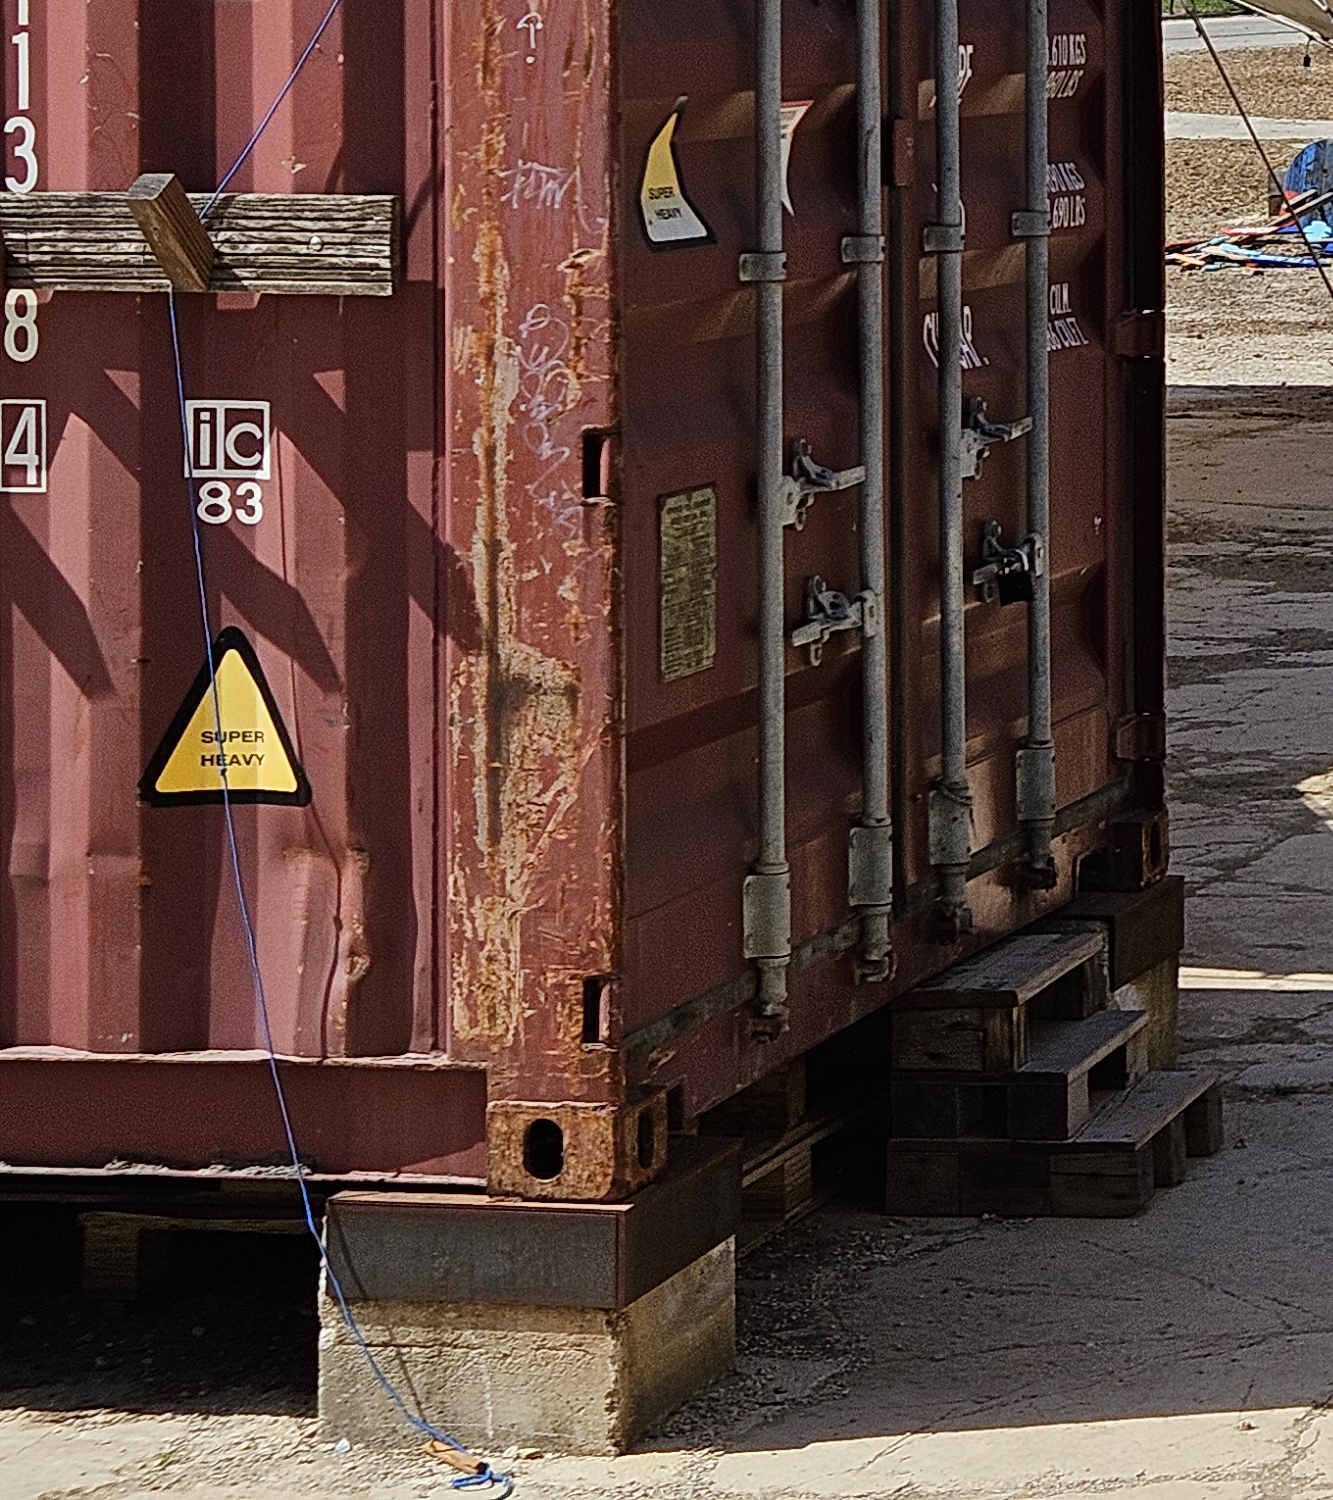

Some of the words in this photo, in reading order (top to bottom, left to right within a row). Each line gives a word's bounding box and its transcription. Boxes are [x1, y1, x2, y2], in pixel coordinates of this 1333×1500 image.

[647, 186, 675, 200] SUPER
[654, 207, 683, 221] HEAVY
[196, 480, 264, 526] 83
[200, 729, 266, 746] SUPER
[200, 752, 267, 769] HEAVY
